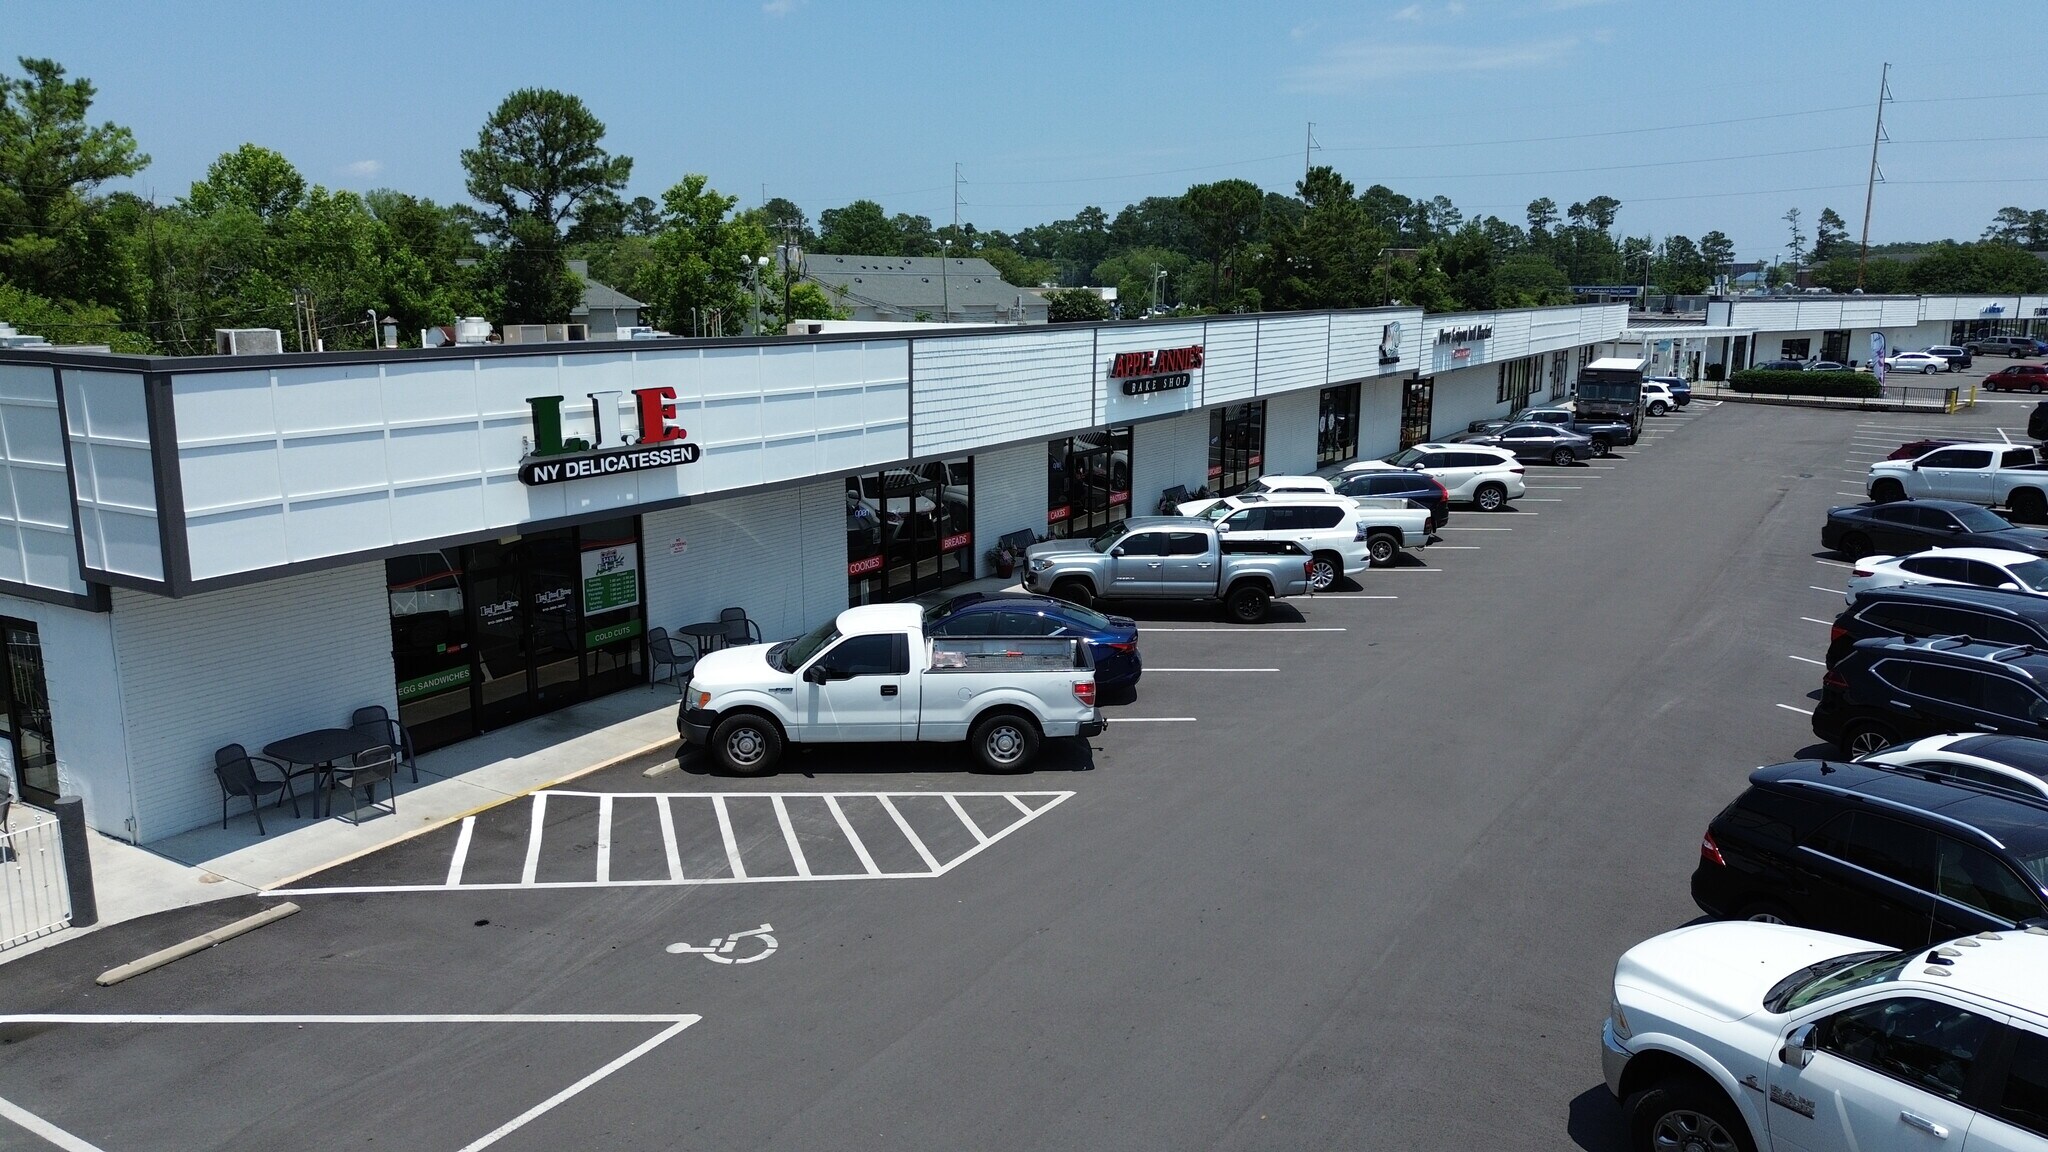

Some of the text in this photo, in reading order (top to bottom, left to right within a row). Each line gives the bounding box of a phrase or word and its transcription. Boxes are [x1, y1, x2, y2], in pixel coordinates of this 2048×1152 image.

[1111, 345, 1203, 378] APPLE ANNIE'S
[1131, 376, 1187, 393] BAKE SHOP
[533, 447, 693, 483] NY DELICATESSEN
[1050, 508, 1066, 520] CAKES
[944, 535, 967, 548] BREADS
[849, 557, 880, 574] COOKIES
[595, 626, 631, 642] COLD CUTS
[398, 669, 470, 696] EGG SANDWICHES
